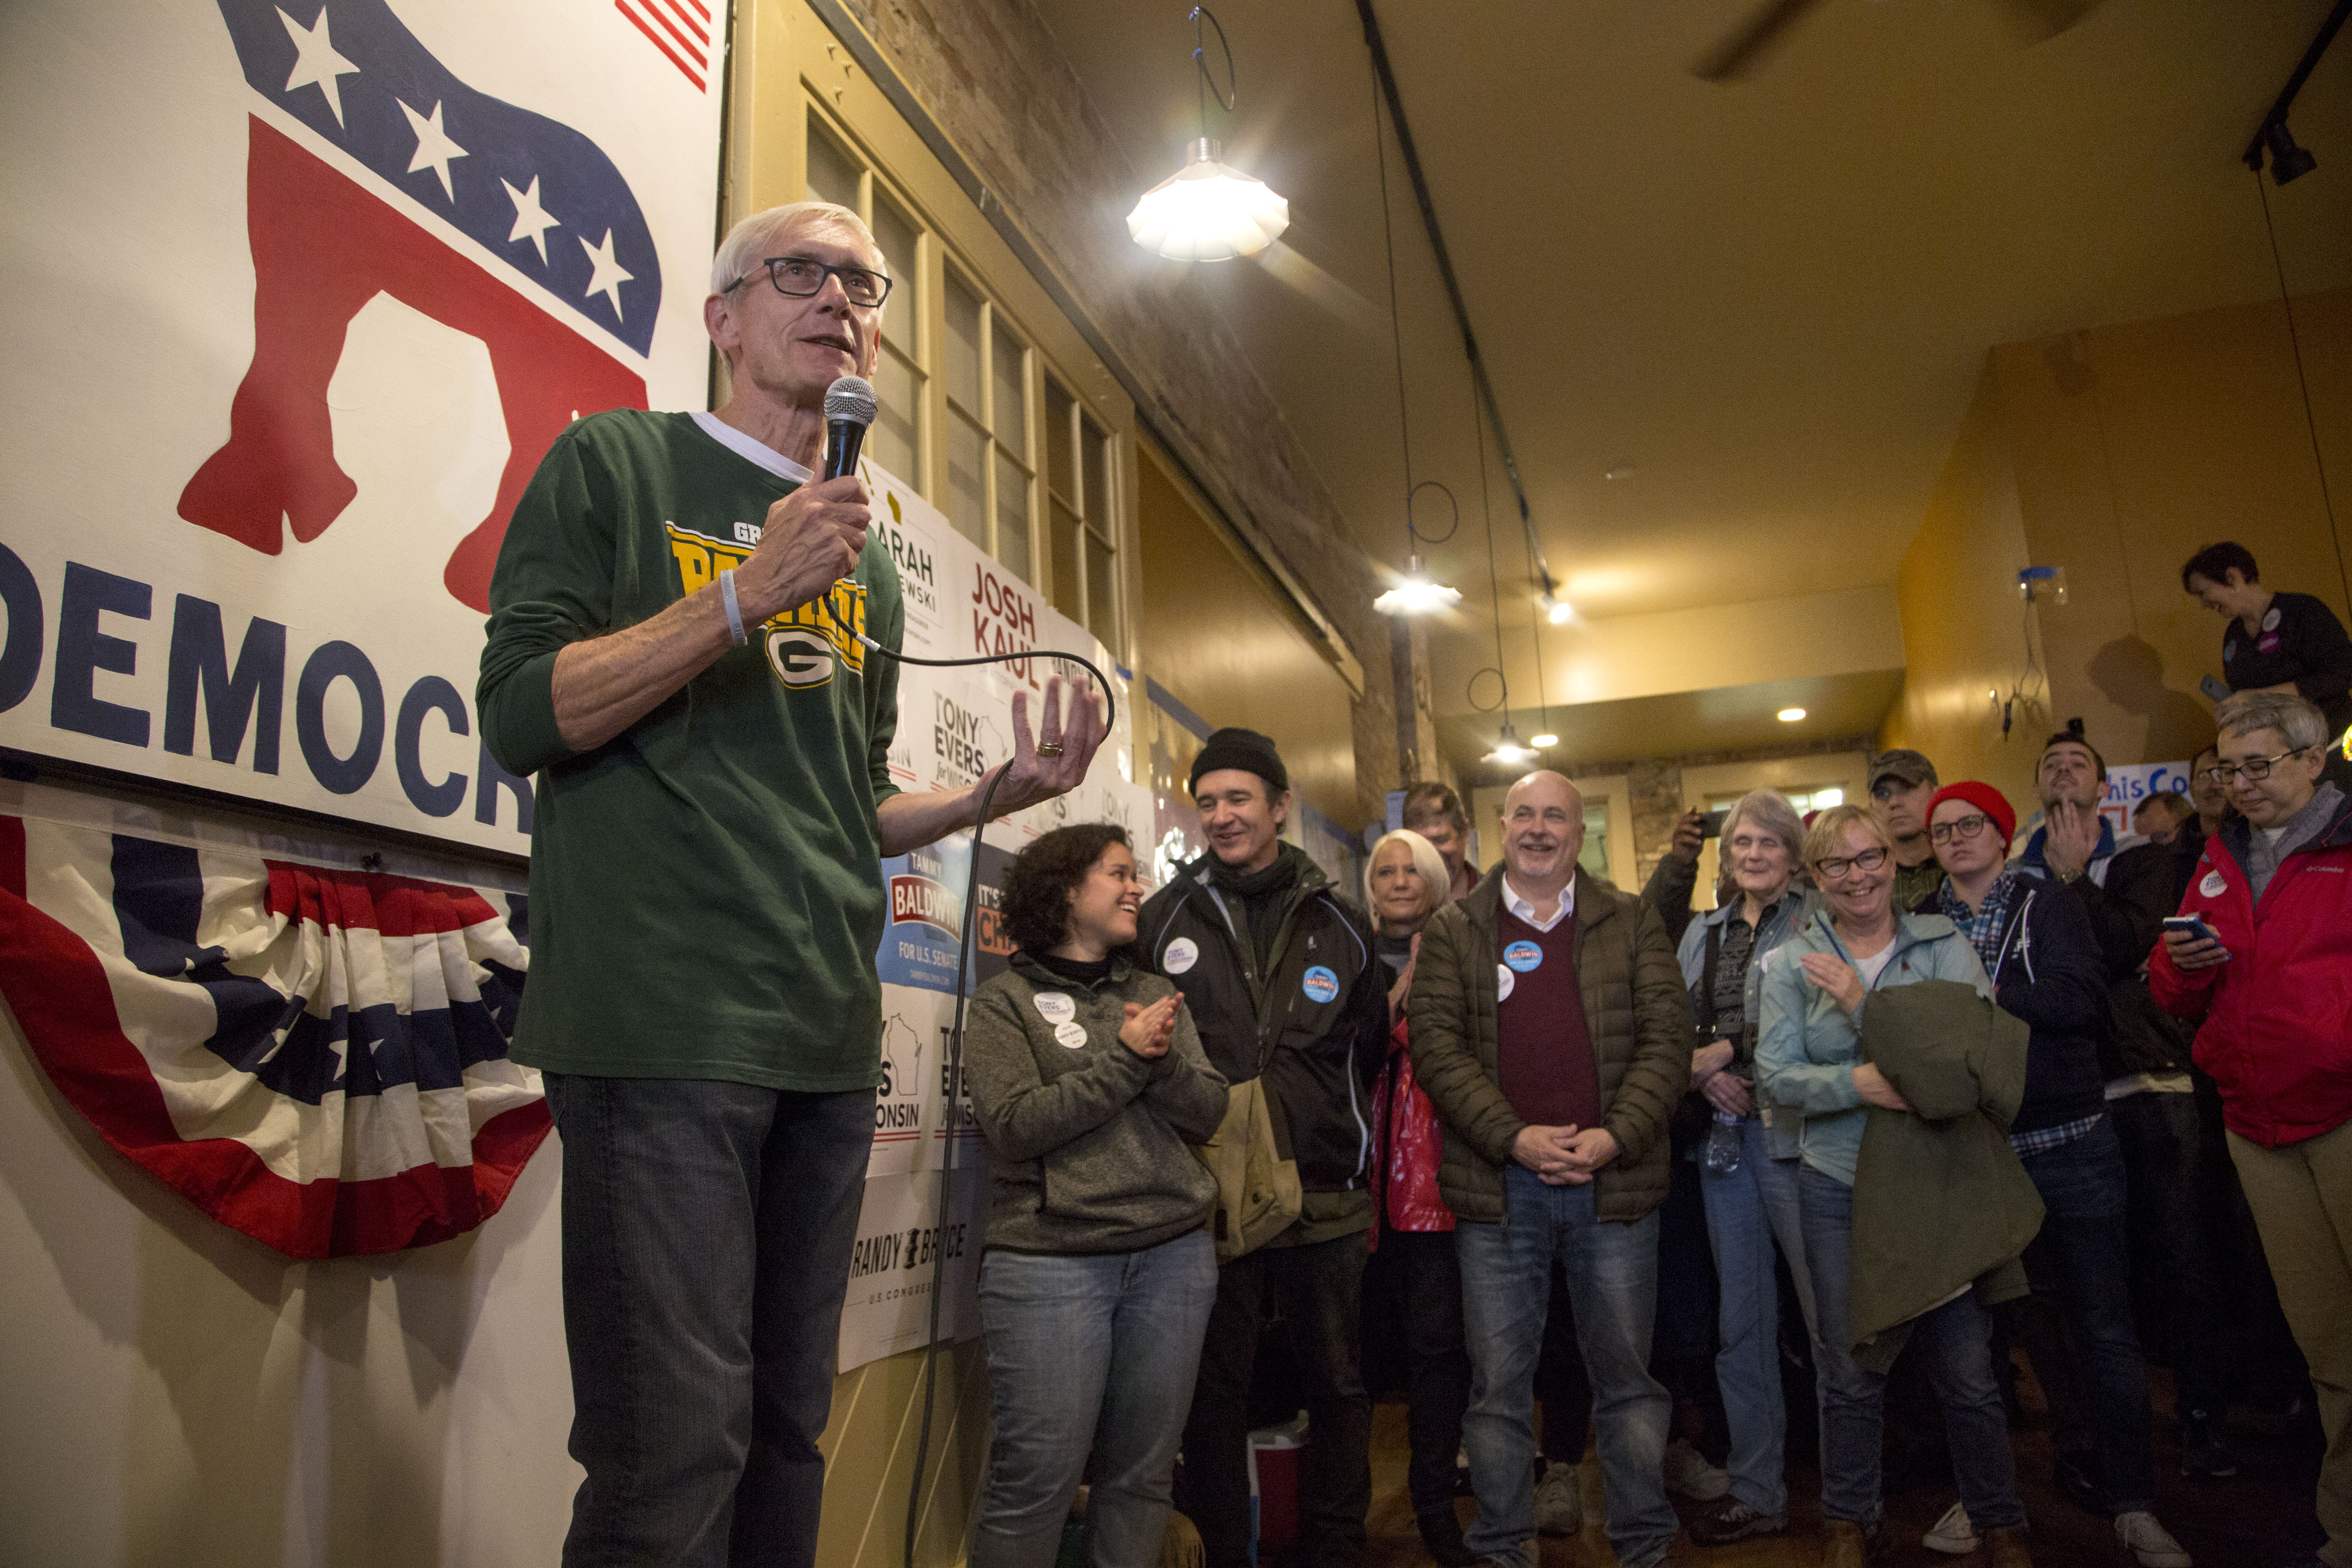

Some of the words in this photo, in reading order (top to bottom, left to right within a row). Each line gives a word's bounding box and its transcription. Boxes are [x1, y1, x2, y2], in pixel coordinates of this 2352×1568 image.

[972, 561, 1036, 644] JOSH
[768, 631, 833, 684] G
[973, 608, 1040, 691] KAUL
[933, 689, 978, 744] TONY
[934, 724, 984, 777] EVERS
[911, 852, 941, 878] TAMMY
[895, 884, 960, 933] BALDWIN
[978, 884, 1000, 909] IT'S
[899, 941, 915, 960] FOR
[851, 1232, 903, 1279] RANDY
[920, 1223, 967, 1265] BRCE
